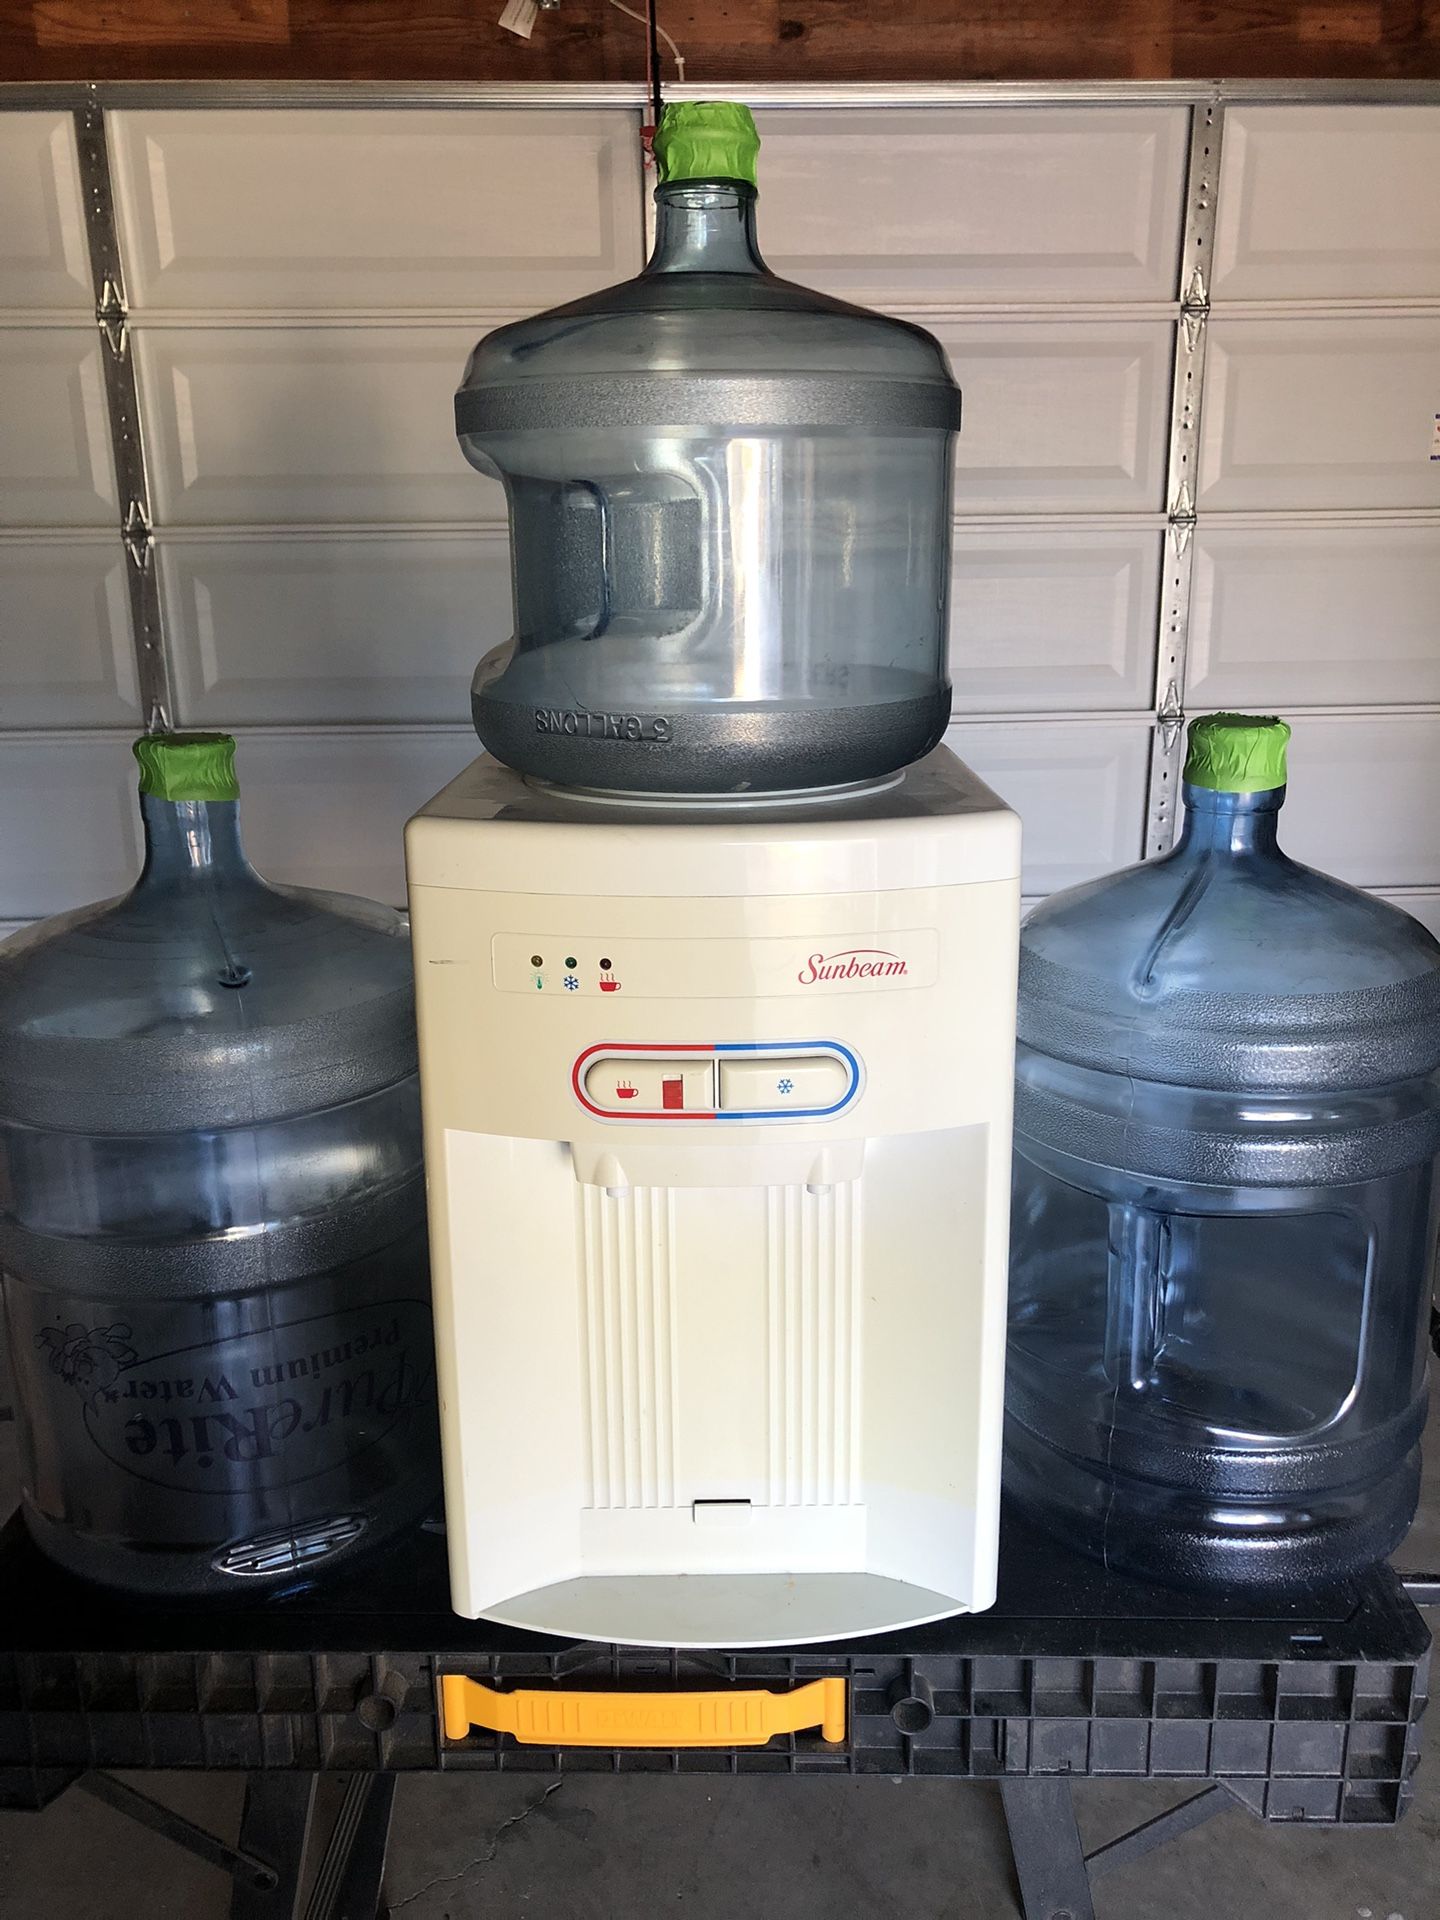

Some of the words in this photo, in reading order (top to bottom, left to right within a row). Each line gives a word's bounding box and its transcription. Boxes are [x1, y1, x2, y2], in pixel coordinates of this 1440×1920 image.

[535, 709, 642, 739] GALLONS
[798, 952, 906, 984] Sunbeam
[250, 1319, 401, 1388] Premium
